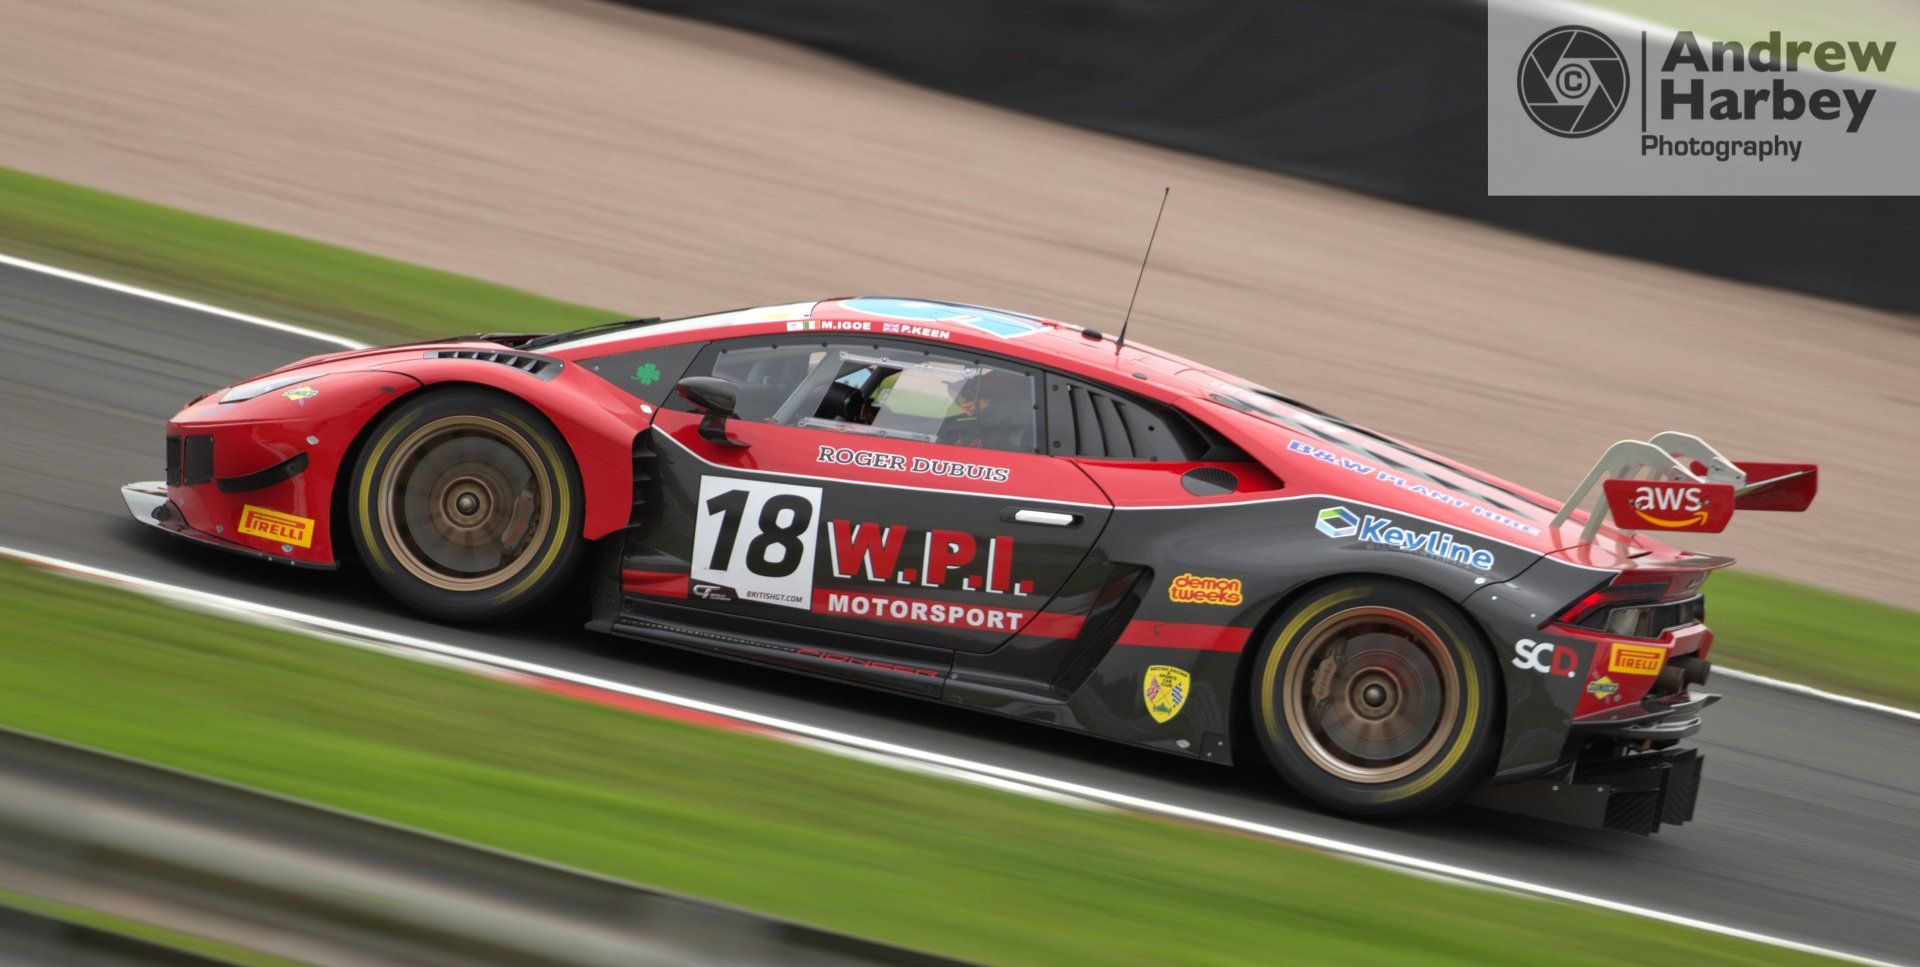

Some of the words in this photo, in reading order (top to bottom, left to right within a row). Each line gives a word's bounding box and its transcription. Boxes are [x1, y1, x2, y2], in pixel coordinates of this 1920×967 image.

[821, 321, 871, 331] M.IGOE
[901, 325, 950, 339] P.KEEN
[817, 445, 906, 472] ROGER
[910, 457, 1010, 482] DUBUIS
[1286, 439, 1376, 475] B&W
[1376, 471, 1471, 508] PLANT
[1634, 486, 1703, 512] aws
[245, 510, 306, 541] PIRELLI
[706, 489, 813, 578] 18
[1358, 515, 1495, 571] Keyline
[827, 519, 1034, 597] W.P.I.
[746, 590, 803, 603] BRITISHGT.COM
[1169, 587, 1243, 605] tweeks
[1174, 573, 1242, 592] demon
[828, 594, 1024, 630] MOTORSPORT
[1615, 649, 1660, 671] PIRELLI
